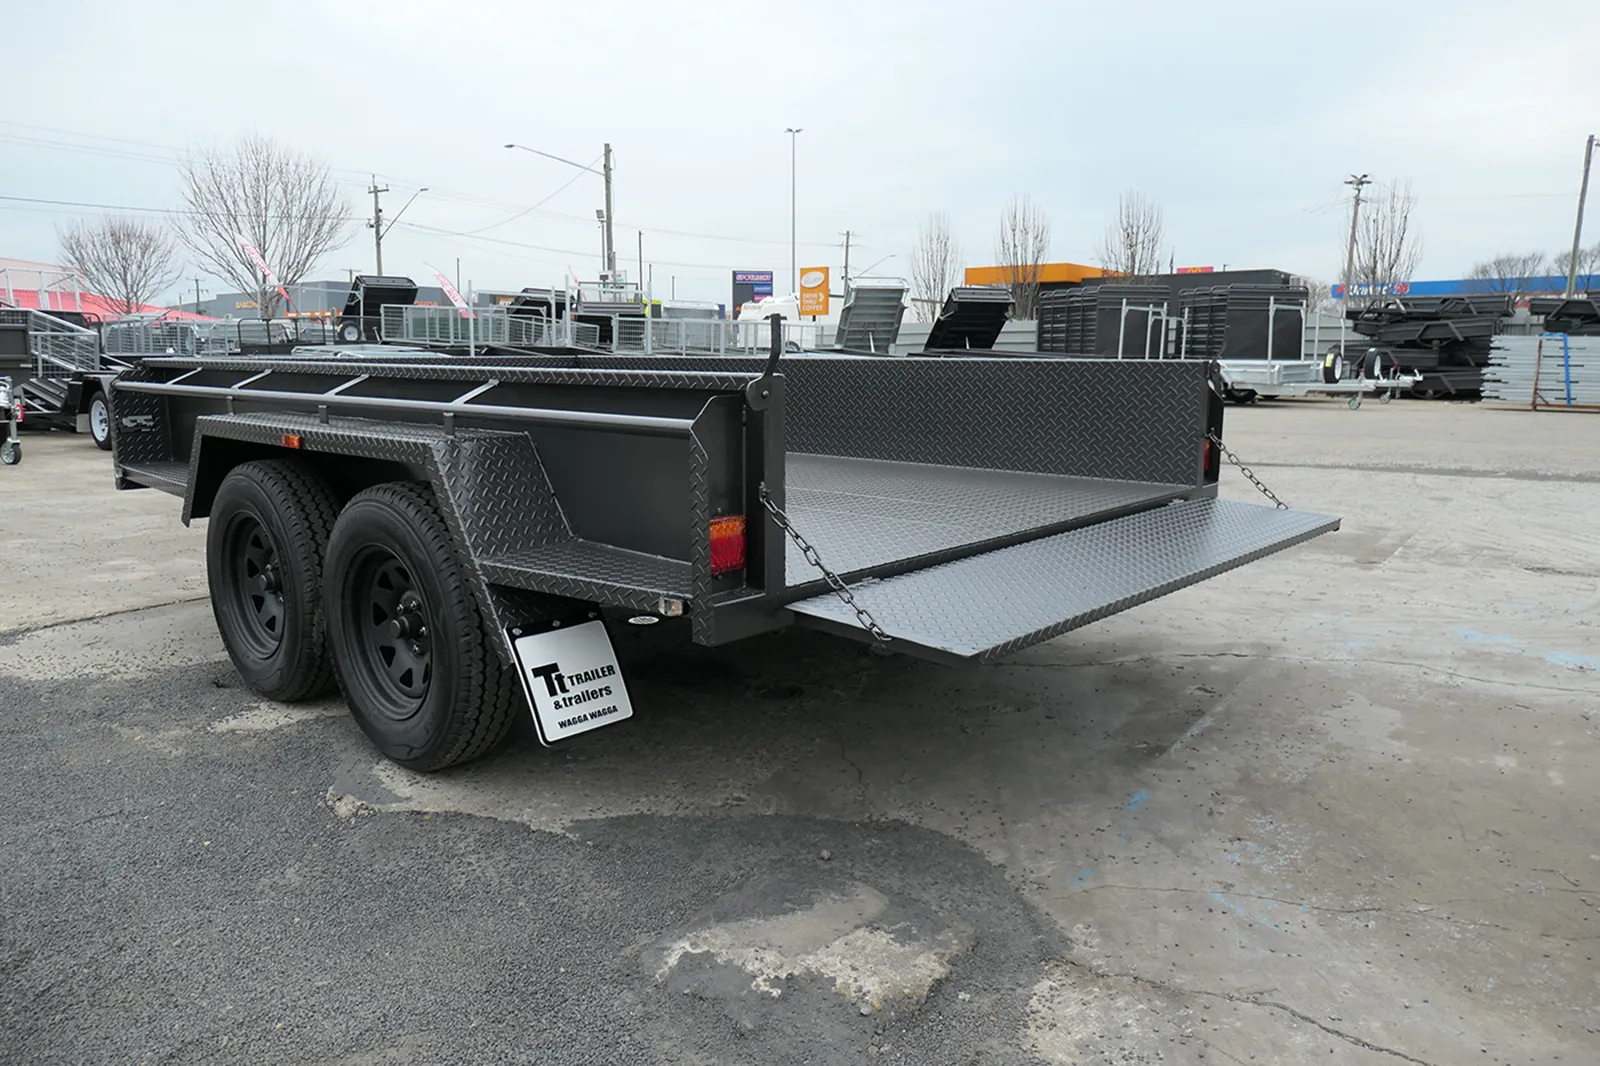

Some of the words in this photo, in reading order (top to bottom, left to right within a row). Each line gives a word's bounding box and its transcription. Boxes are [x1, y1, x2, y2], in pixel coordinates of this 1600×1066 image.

[1393, 282, 1410, 295] 24
[567, 664, 616, 687] TRAILER
[557, 713, 589, 729] WAGGA
[588, 704, 619, 720] WAGGA
